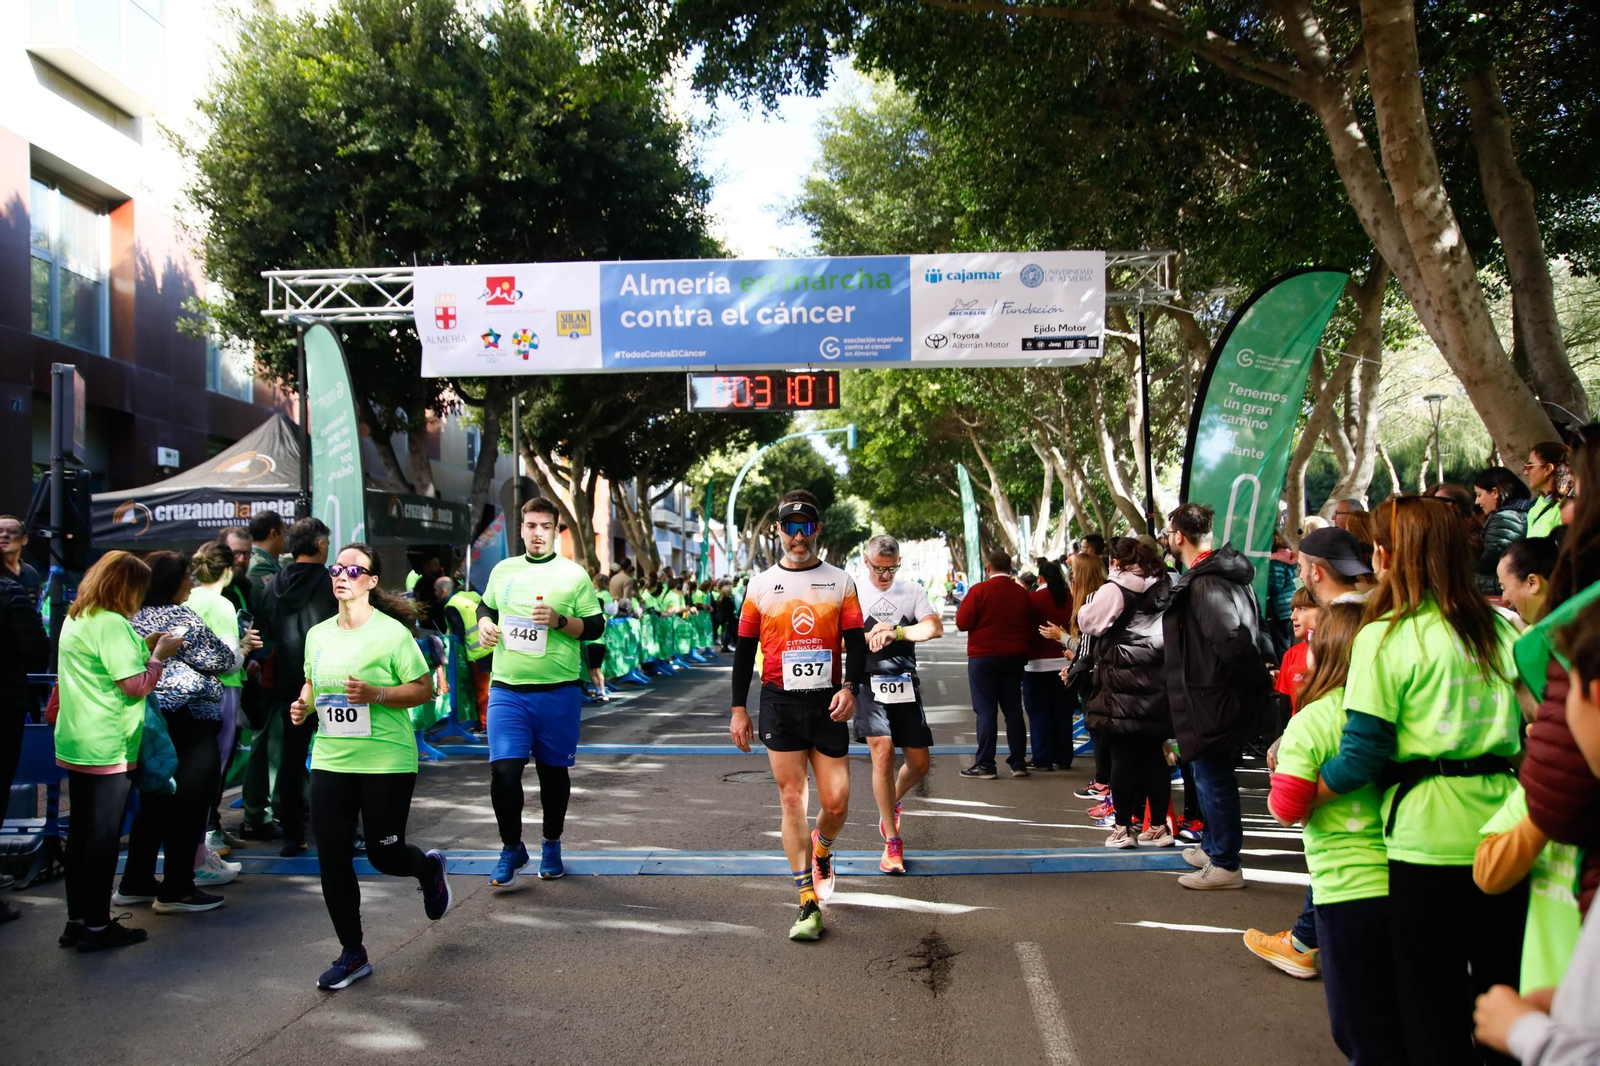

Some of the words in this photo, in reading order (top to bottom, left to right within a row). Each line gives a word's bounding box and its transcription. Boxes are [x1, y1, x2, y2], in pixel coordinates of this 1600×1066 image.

[946, 268, 1003, 284] cajamar
[1044, 269, 1093, 277] UNIVERSIDAD
[1044, 275, 1055, 283] DE
[619, 271, 730, 296] Almería
[740, 275, 782, 292] en
[784, 268, 892, 291] marcha
[620, 308, 713, 328] contra
[721, 304, 749, 326] el
[757, 301, 856, 325] cáncer
[1000, 301, 1064, 315] Fundación
[1034, 324, 1056, 335] Ejido
[1058, 323, 1087, 333] Motor
[425, 333, 467, 344] ALMERÍA
[951, 332, 980, 342] Toyota
[951, 340, 982, 349] Alborán
[985, 340, 1010, 349] Motor
[614, 349, 706, 360] #TodosContraElCáncer
[1228, 381, 1288, 403] Tenemos
[1223, 398, 1240, 410] un
[1242, 402, 1273, 416] gran
[1219, 413, 1269, 430] camino
[509, 627, 539, 642] 448
[792, 662, 825, 677] 637
[879, 682, 905, 694] 601
[326, 707, 358, 723] 180
